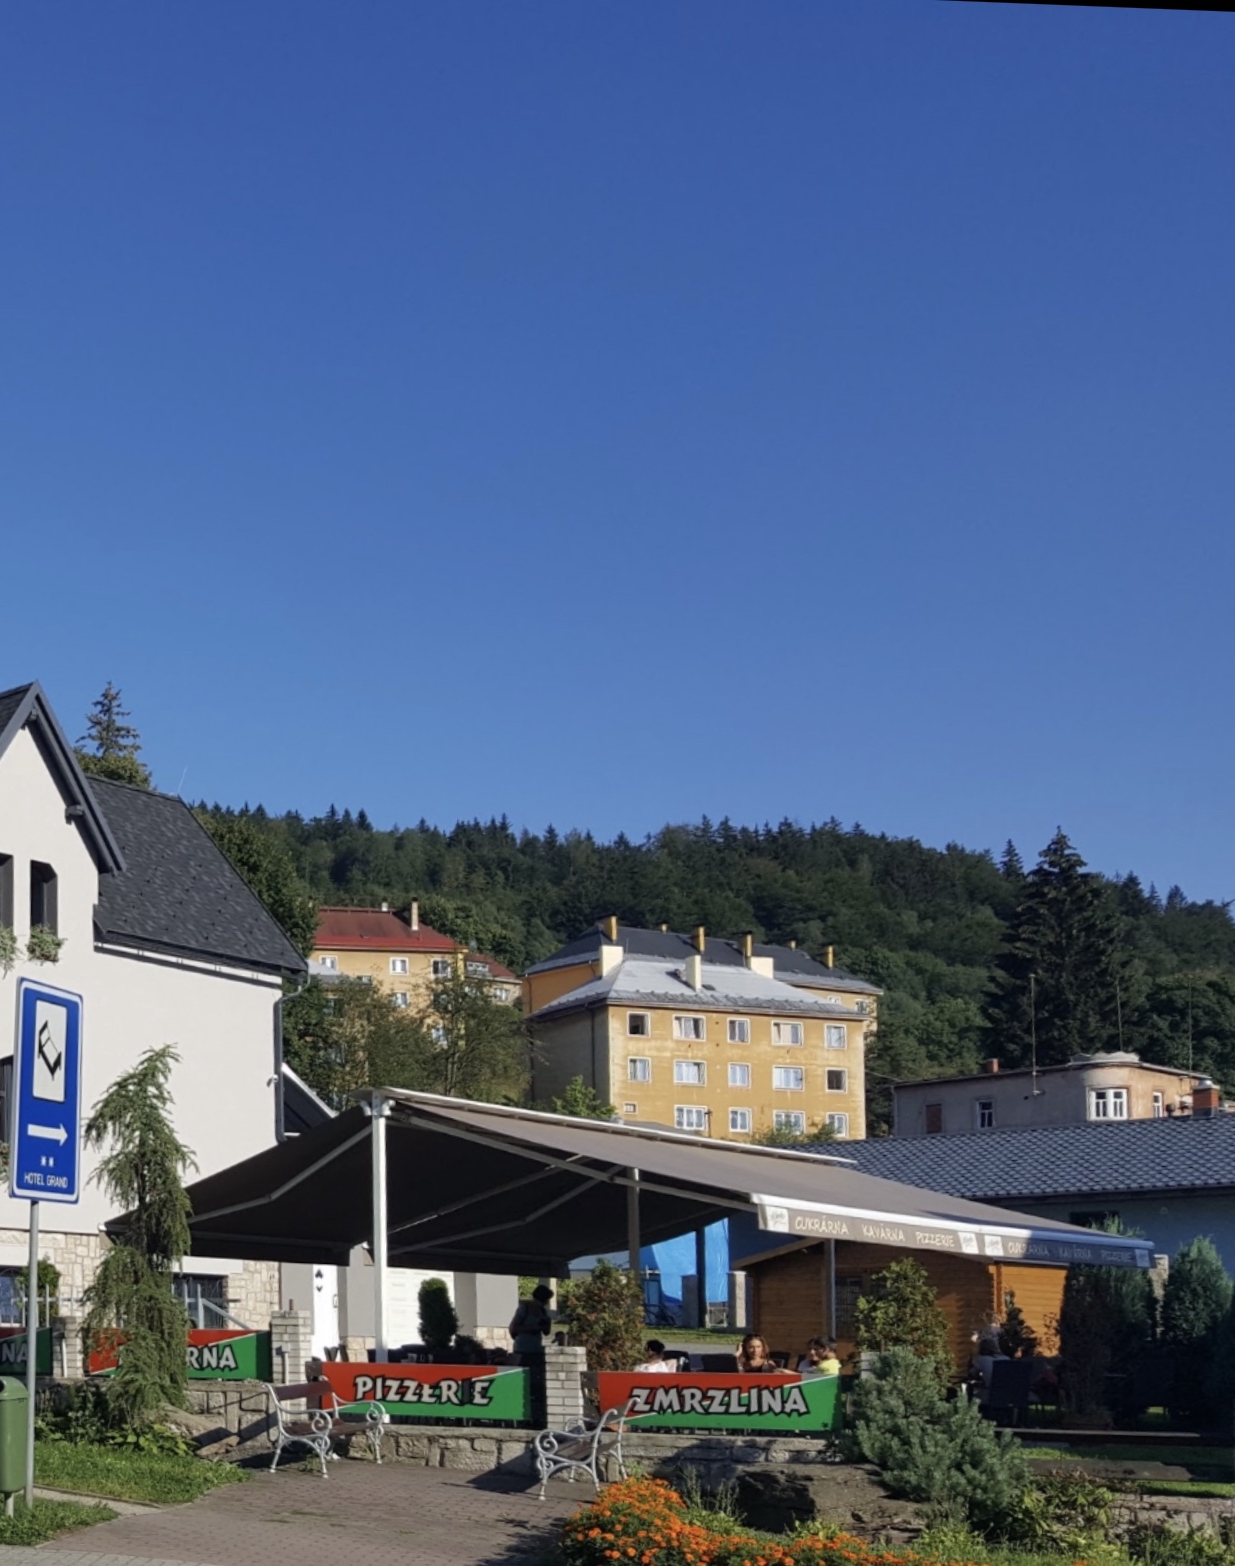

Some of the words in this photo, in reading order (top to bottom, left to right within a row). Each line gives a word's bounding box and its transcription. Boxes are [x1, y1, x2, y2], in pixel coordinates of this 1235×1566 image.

[24, 1171, 45, 1186] HOTEL
[46, 1174, 69, 1189] GRAND
[795, 1215, 849, 1235] CUKRÁRNA
[862, 1223, 906, 1242] KAVÁRNA
[915, 1231, 955, 1248] PIZZERIE
[354, 1375, 491, 1405] PIZZERE
[630, 1386, 809, 1416] ZMRZLINA
